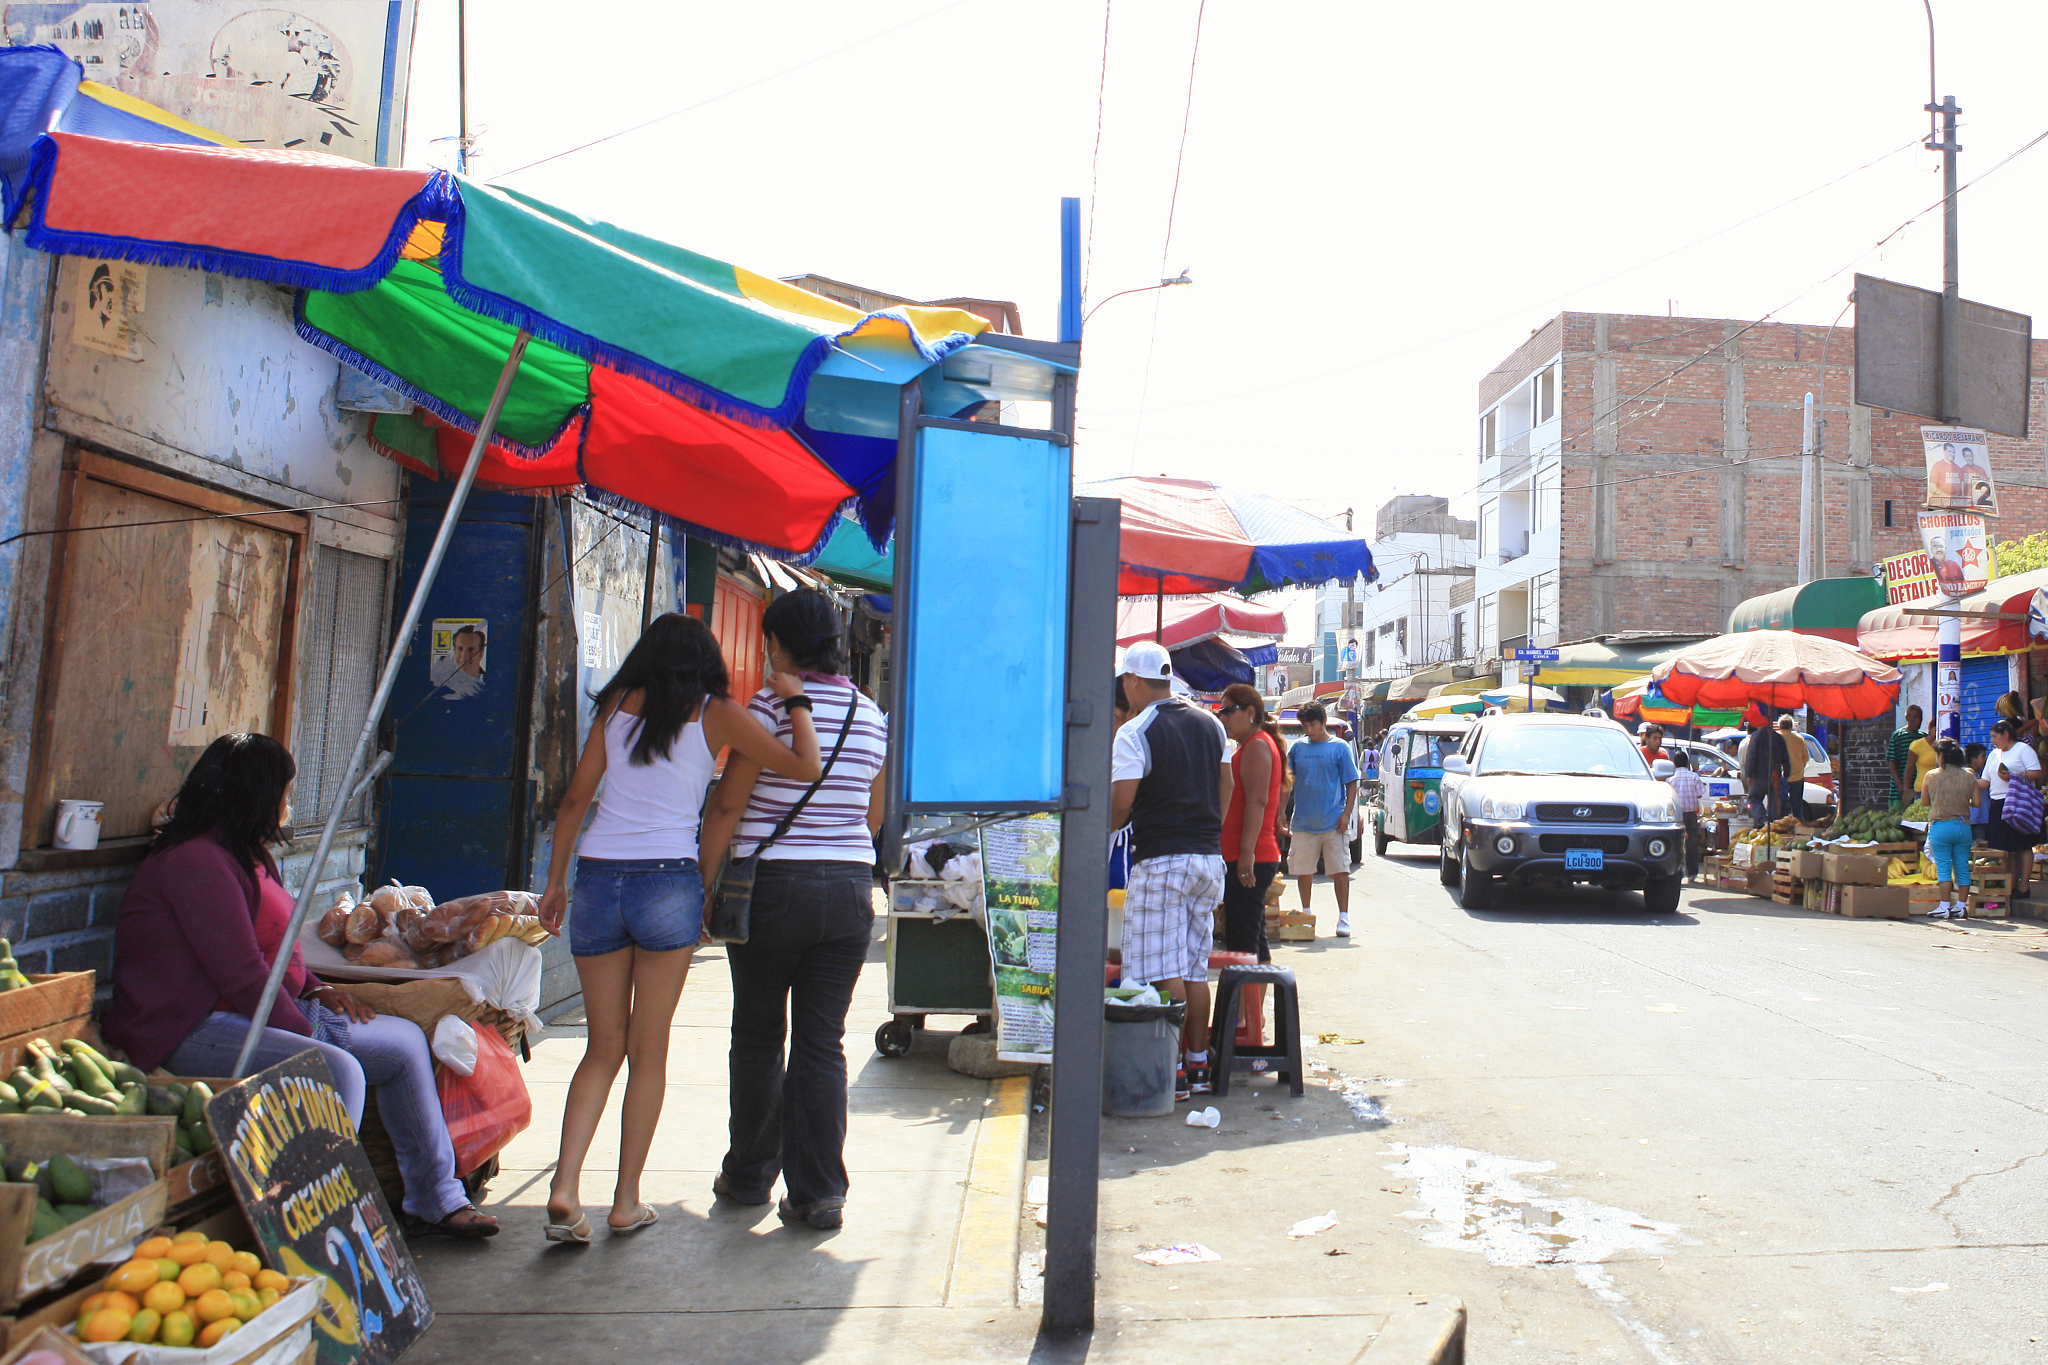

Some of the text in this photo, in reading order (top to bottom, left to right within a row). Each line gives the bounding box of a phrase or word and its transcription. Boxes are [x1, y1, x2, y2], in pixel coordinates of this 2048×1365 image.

[1925, 432, 1984, 444] RICARDO BEJARANO
[1975, 482, 1993, 506] 2
[1920, 514, 1980, 529] CHORRILLOS
[1950, 527, 1981, 539] para todos
[1416, 790, 1423, 802] 9
[1567, 857, 1602, 867] LGU-900
[998, 893, 1040, 906] LA TUNA
[1021, 983, 1050, 996] SABILA
[282, 1162, 359, 1241] CREMOSA
[25, 1202, 145, 1293] CECILIA
[352, 1203, 405, 1318] 1
[325, 1226, 383, 1341] 2
